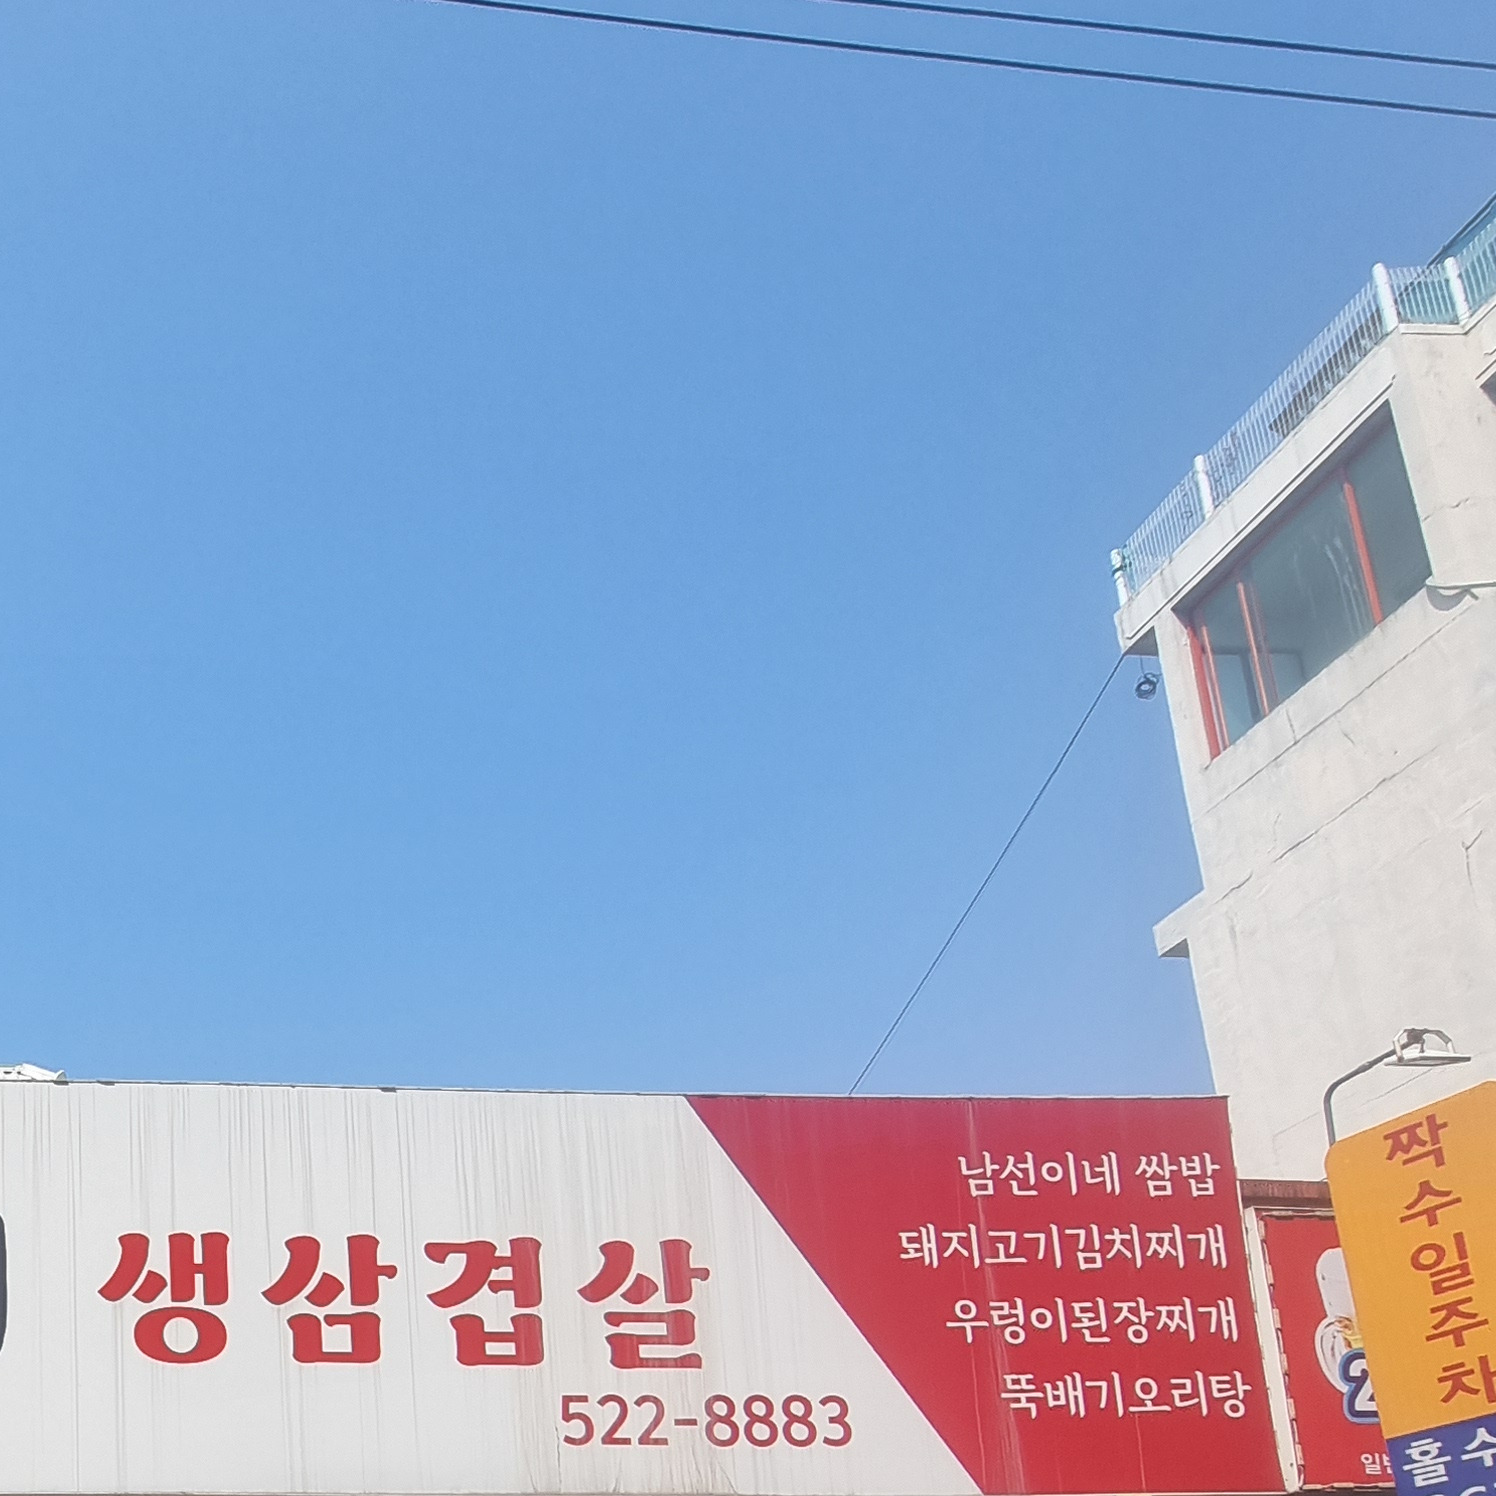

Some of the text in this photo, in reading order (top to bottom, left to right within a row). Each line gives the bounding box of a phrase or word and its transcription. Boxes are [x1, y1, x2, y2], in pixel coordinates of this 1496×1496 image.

[958, 1151, 1221, 1198] 남선이네 쌈밥
[898, 1223, 1228, 1270] 돼지고기김치찌개
[97, 1231, 711, 1369] 생삼겹살
[946, 1296, 1240, 1345] 우렁이된장찌개
[1000, 1370, 1253, 1419] 뚝배기오리탕
[560, 1394, 853, 1448] 522-8883
